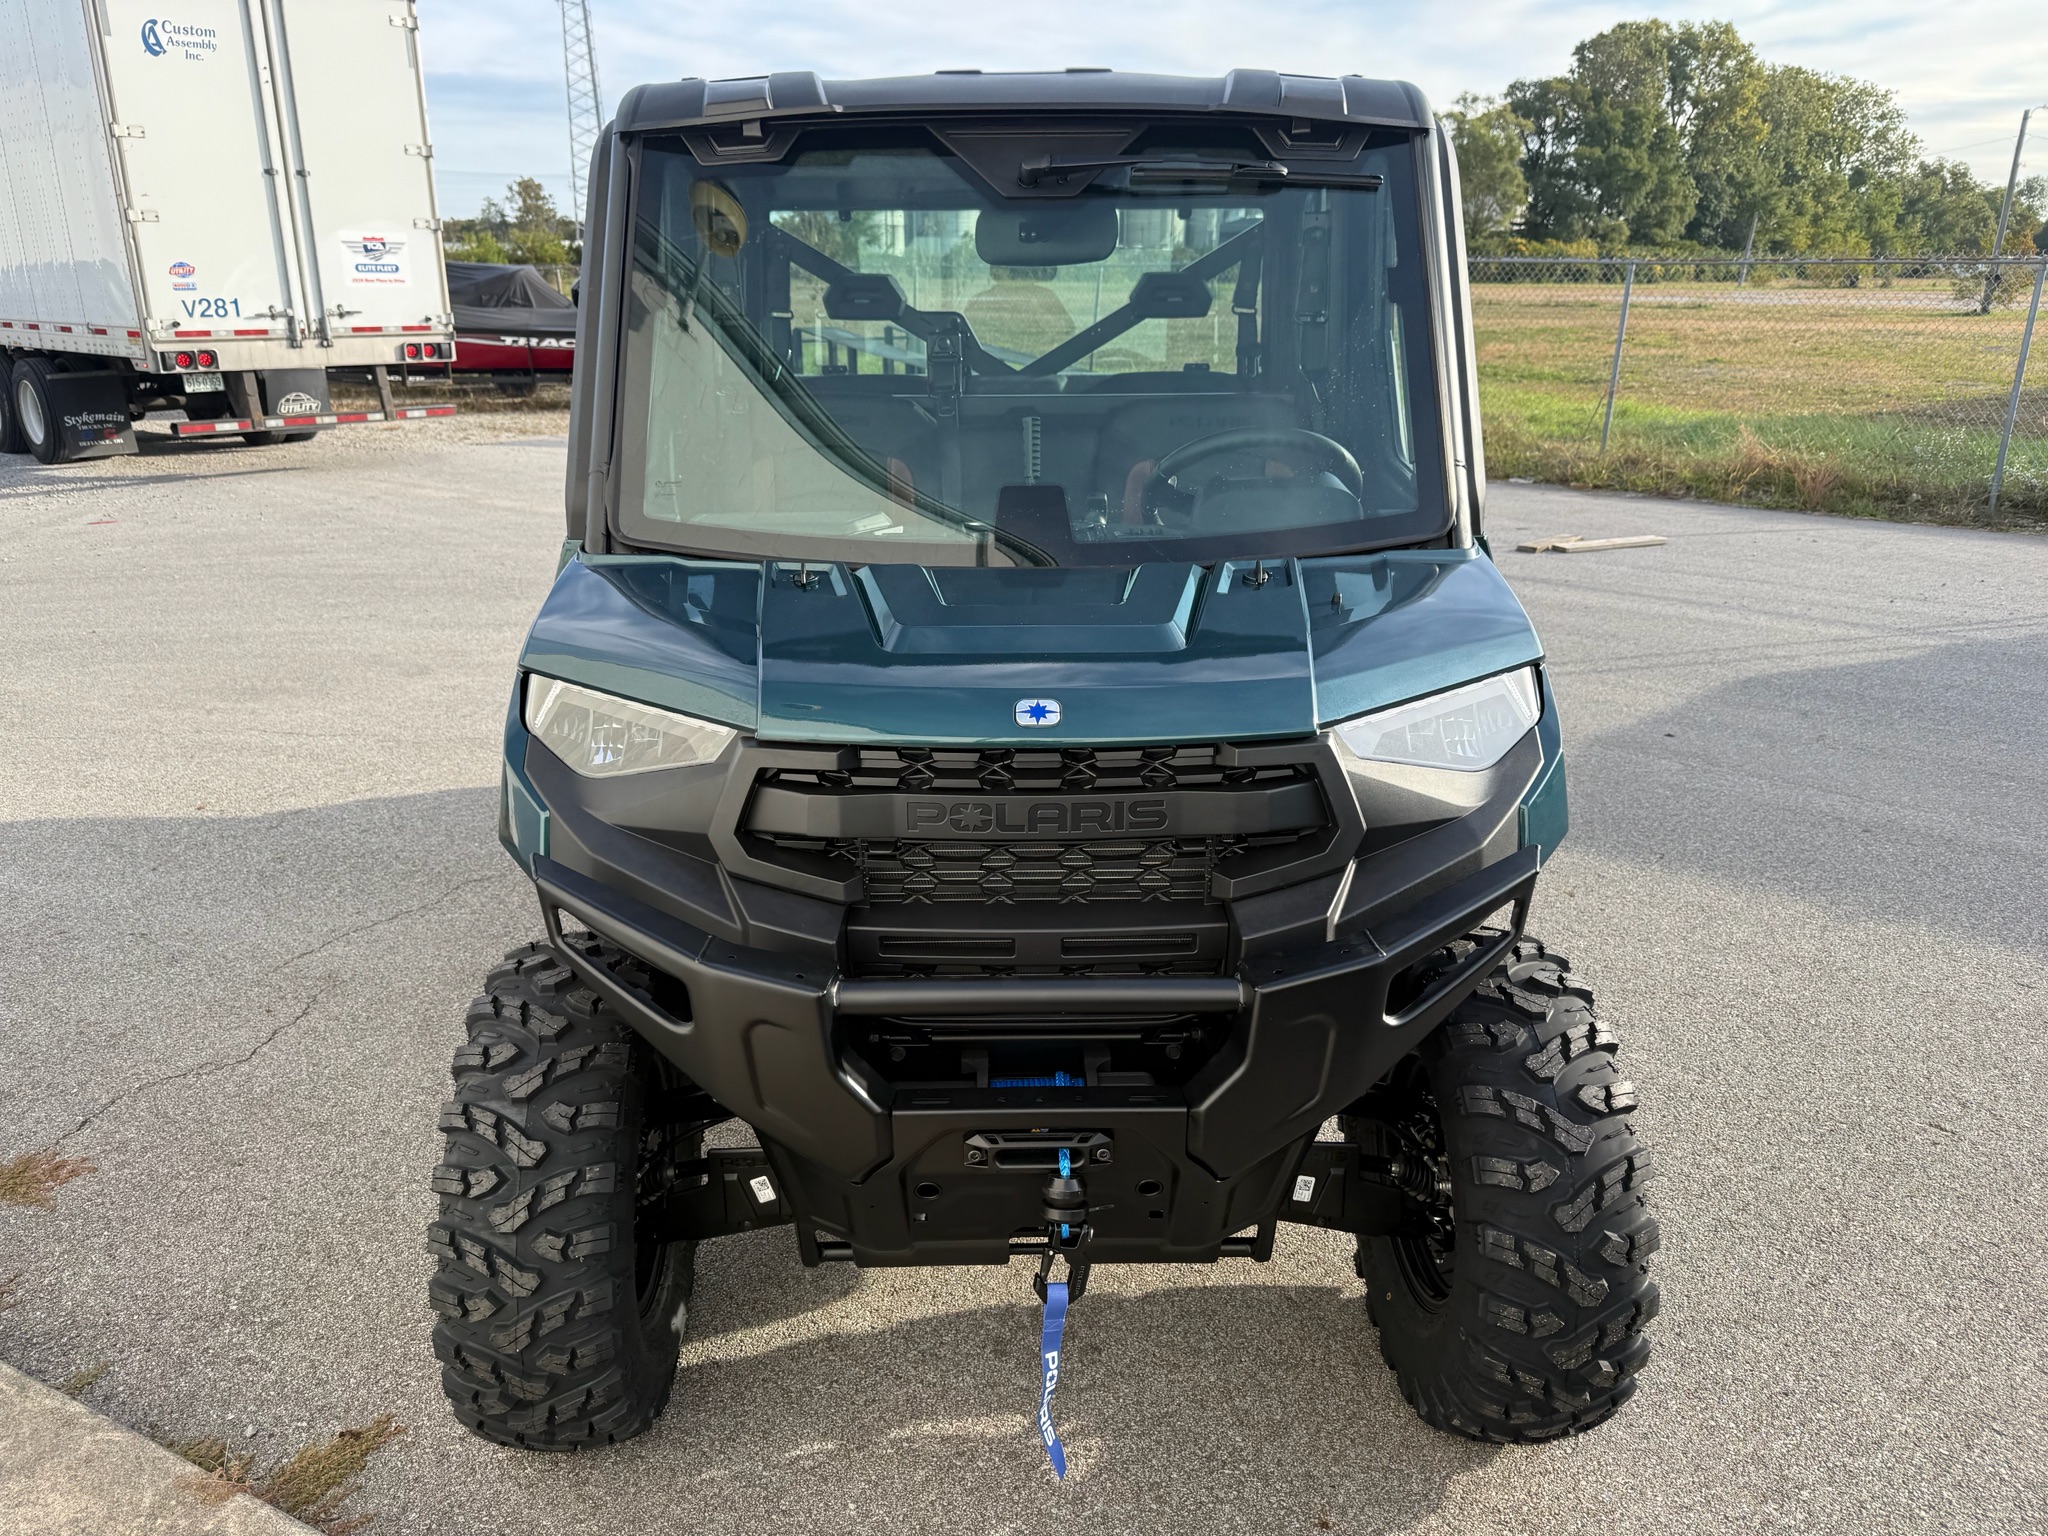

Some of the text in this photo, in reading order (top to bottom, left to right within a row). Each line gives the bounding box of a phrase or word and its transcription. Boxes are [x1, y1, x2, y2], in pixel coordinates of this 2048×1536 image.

[161, 19, 216, 38] Custom
[166, 35, 217, 52] Assembly
[185, 49, 204, 61] Inc.
[181, 297, 240, 318] V281
[280, 401, 319, 414] UTILITY
[63, 411, 125, 427] Stykemain
[906, 800, 1169, 834] POLARIS
